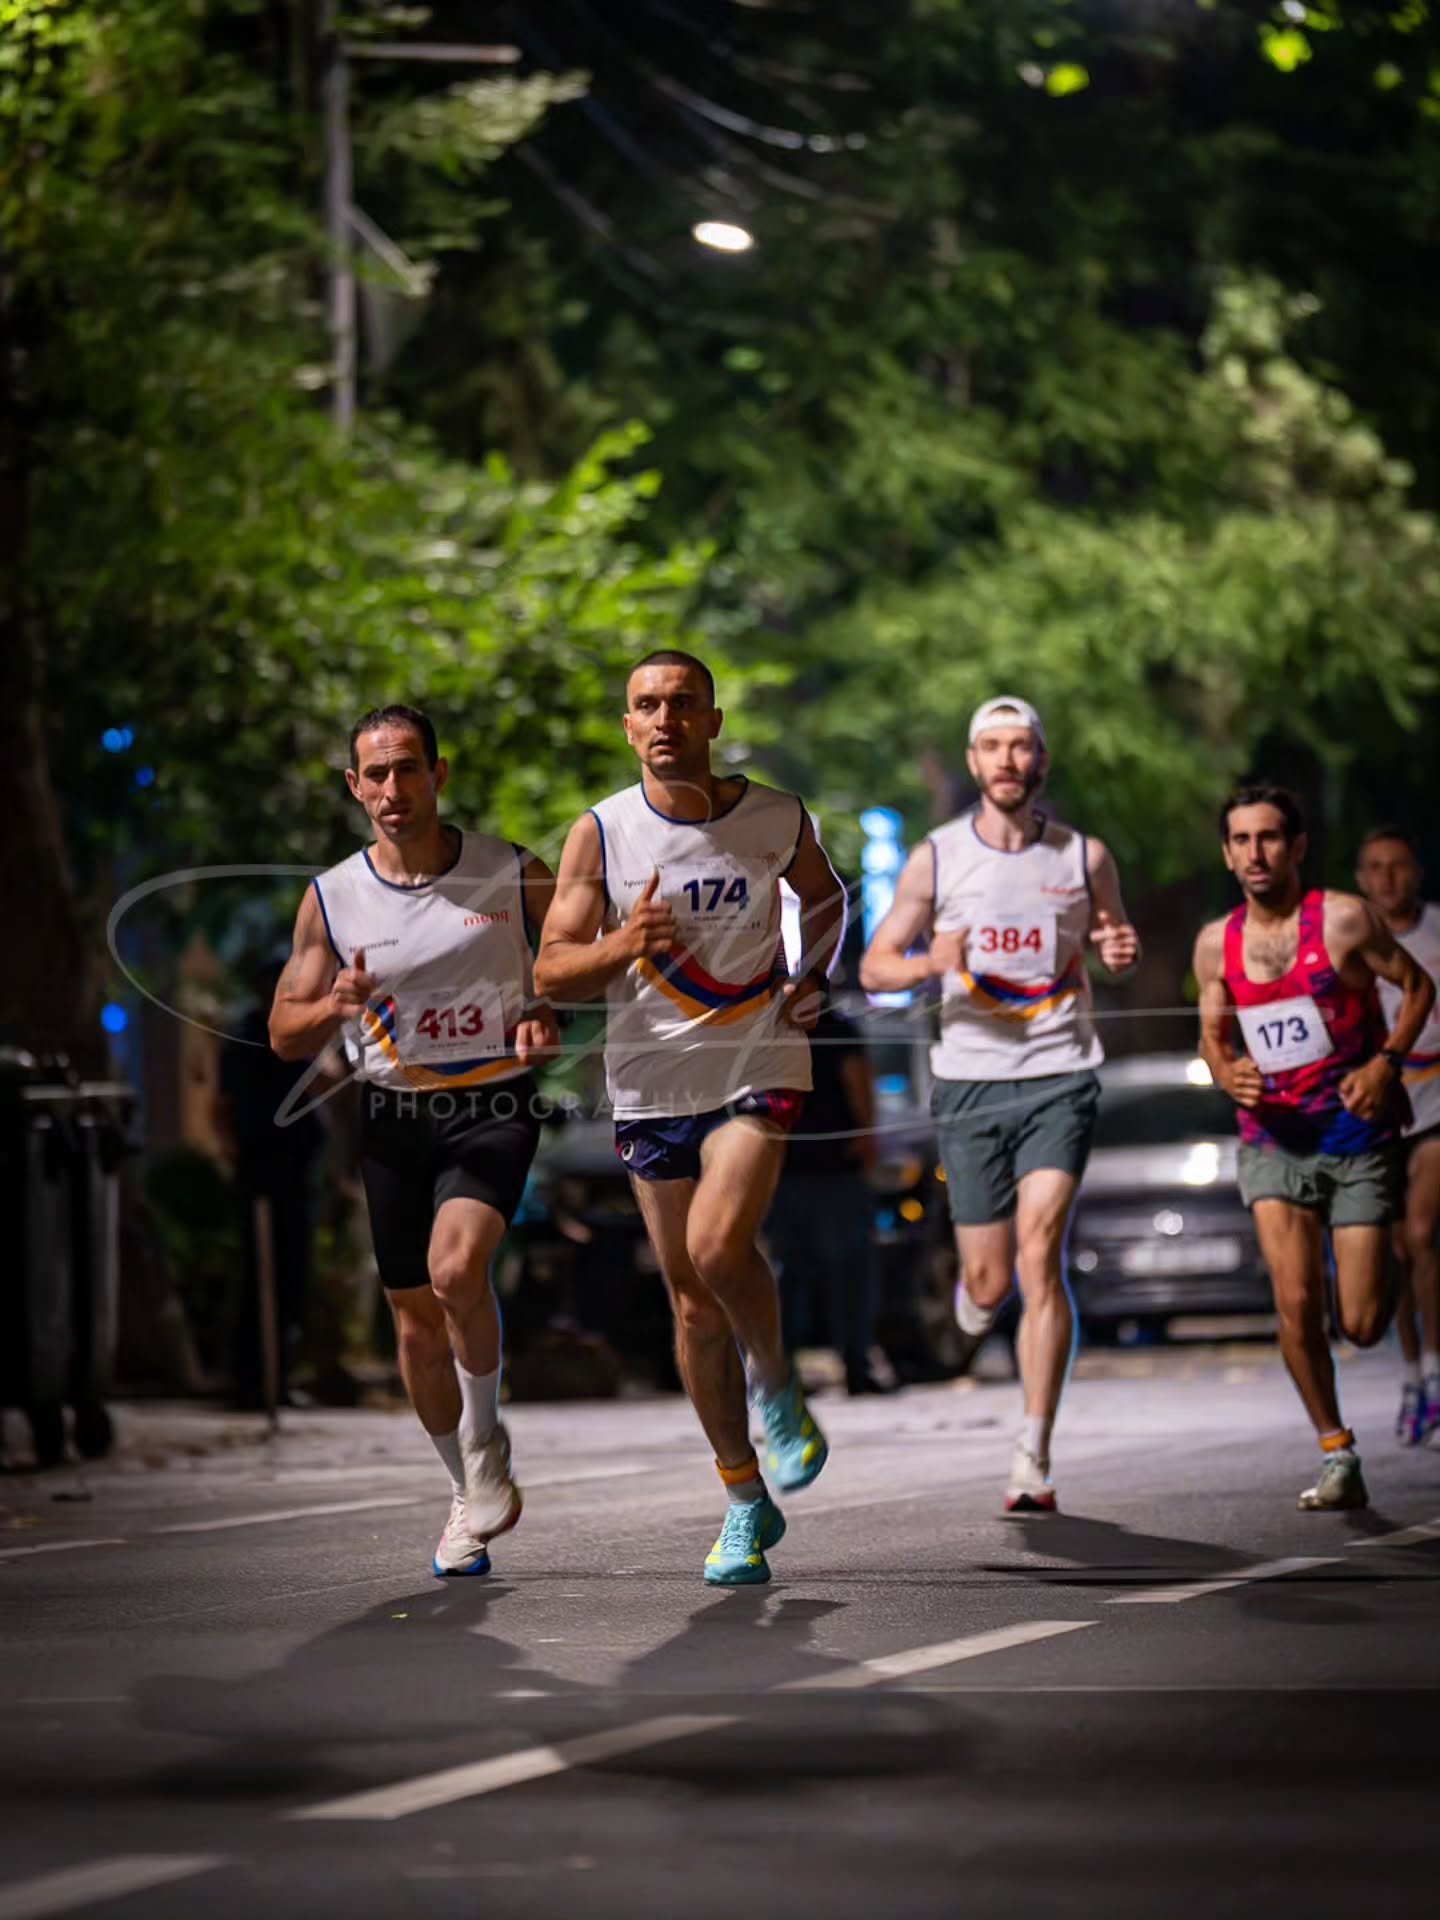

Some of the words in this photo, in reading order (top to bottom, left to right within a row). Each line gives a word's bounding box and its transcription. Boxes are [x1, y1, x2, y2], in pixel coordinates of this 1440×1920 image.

[683, 876, 749, 912] 174
[979, 927, 1042, 954] 384
[416, 1003, 484, 1041] 413
[1257, 1015, 1309, 1049] 173
